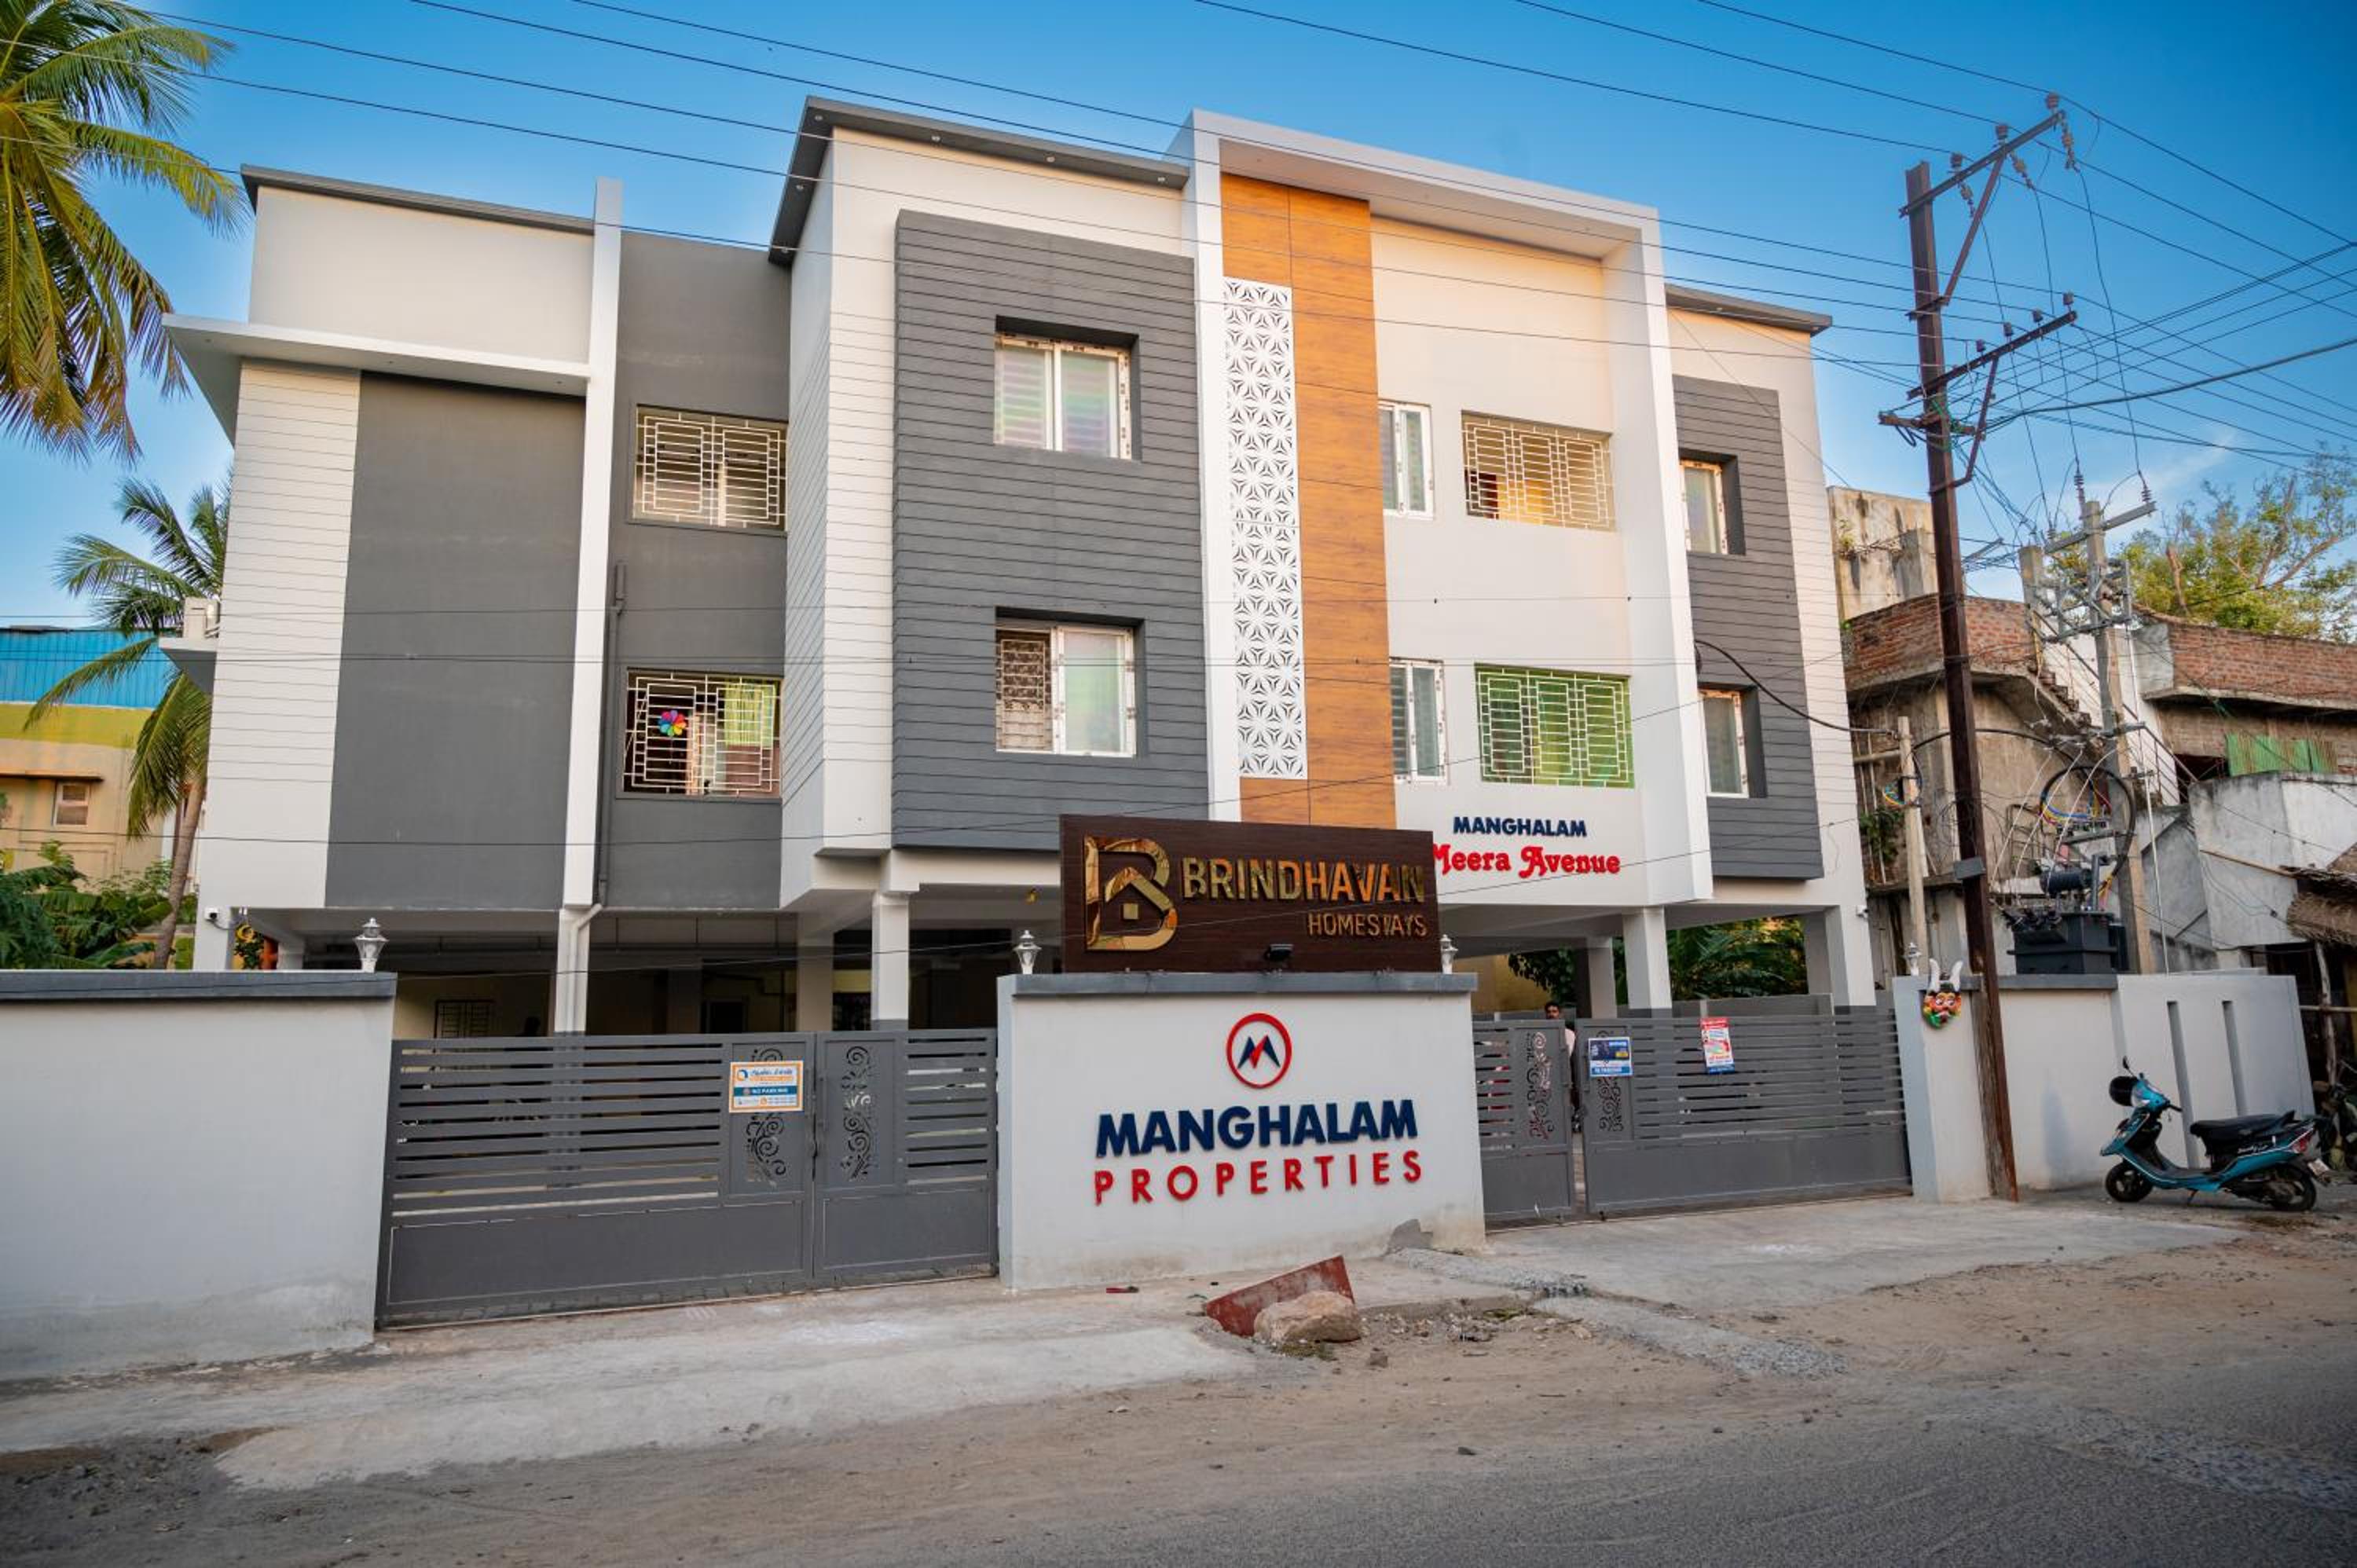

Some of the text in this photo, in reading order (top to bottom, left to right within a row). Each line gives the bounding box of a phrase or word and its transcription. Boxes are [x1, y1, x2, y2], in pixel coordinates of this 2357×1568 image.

[1453, 816, 1587, 837] MANGHALAM
[1182, 857, 1425, 903] BRINDHAVAN
[1432, 843, 1621, 878] Meera Avenue
[1308, 912, 1428, 937] HOMESTAYS
[1096, 1099, 1418, 1157] MANGHALAM
[1094, 1149, 1422, 1205] PROPERTIES
